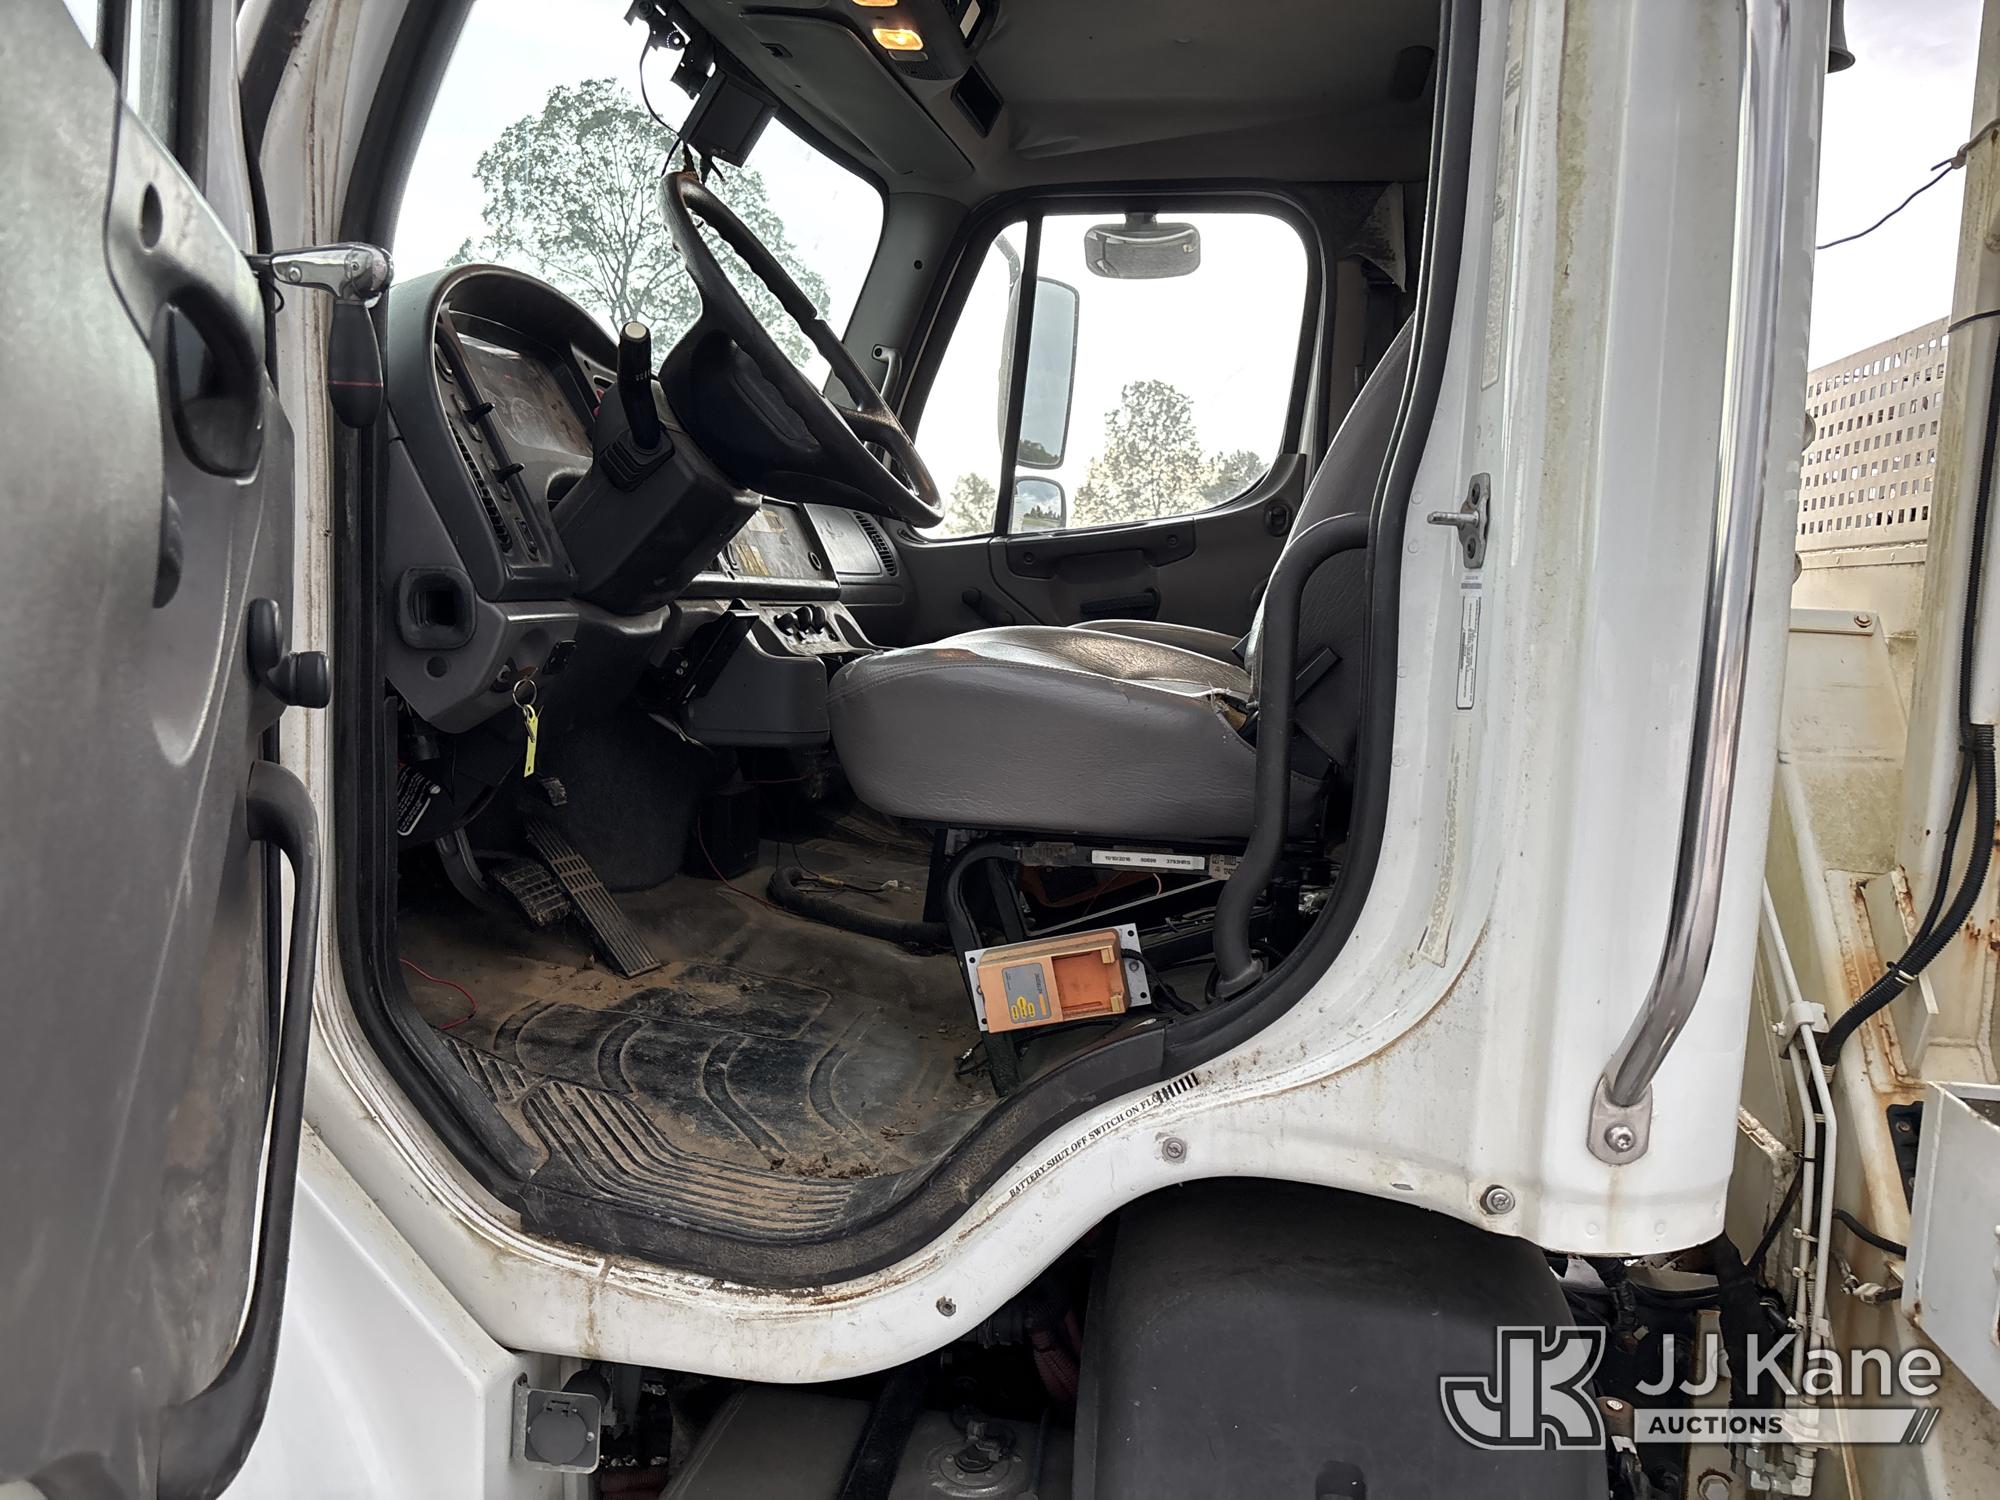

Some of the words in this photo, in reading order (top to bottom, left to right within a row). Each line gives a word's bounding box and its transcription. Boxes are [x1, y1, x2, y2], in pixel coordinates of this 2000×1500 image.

[1009, 1165, 1046, 1198] BATTERY
[1046, 1149, 1071, 1170] SHUT
[1071, 1136, 1088, 1154] OFF
[1088, 1114, 1125, 1141] SWITCH
[1125, 1105, 1140, 1119] ON
